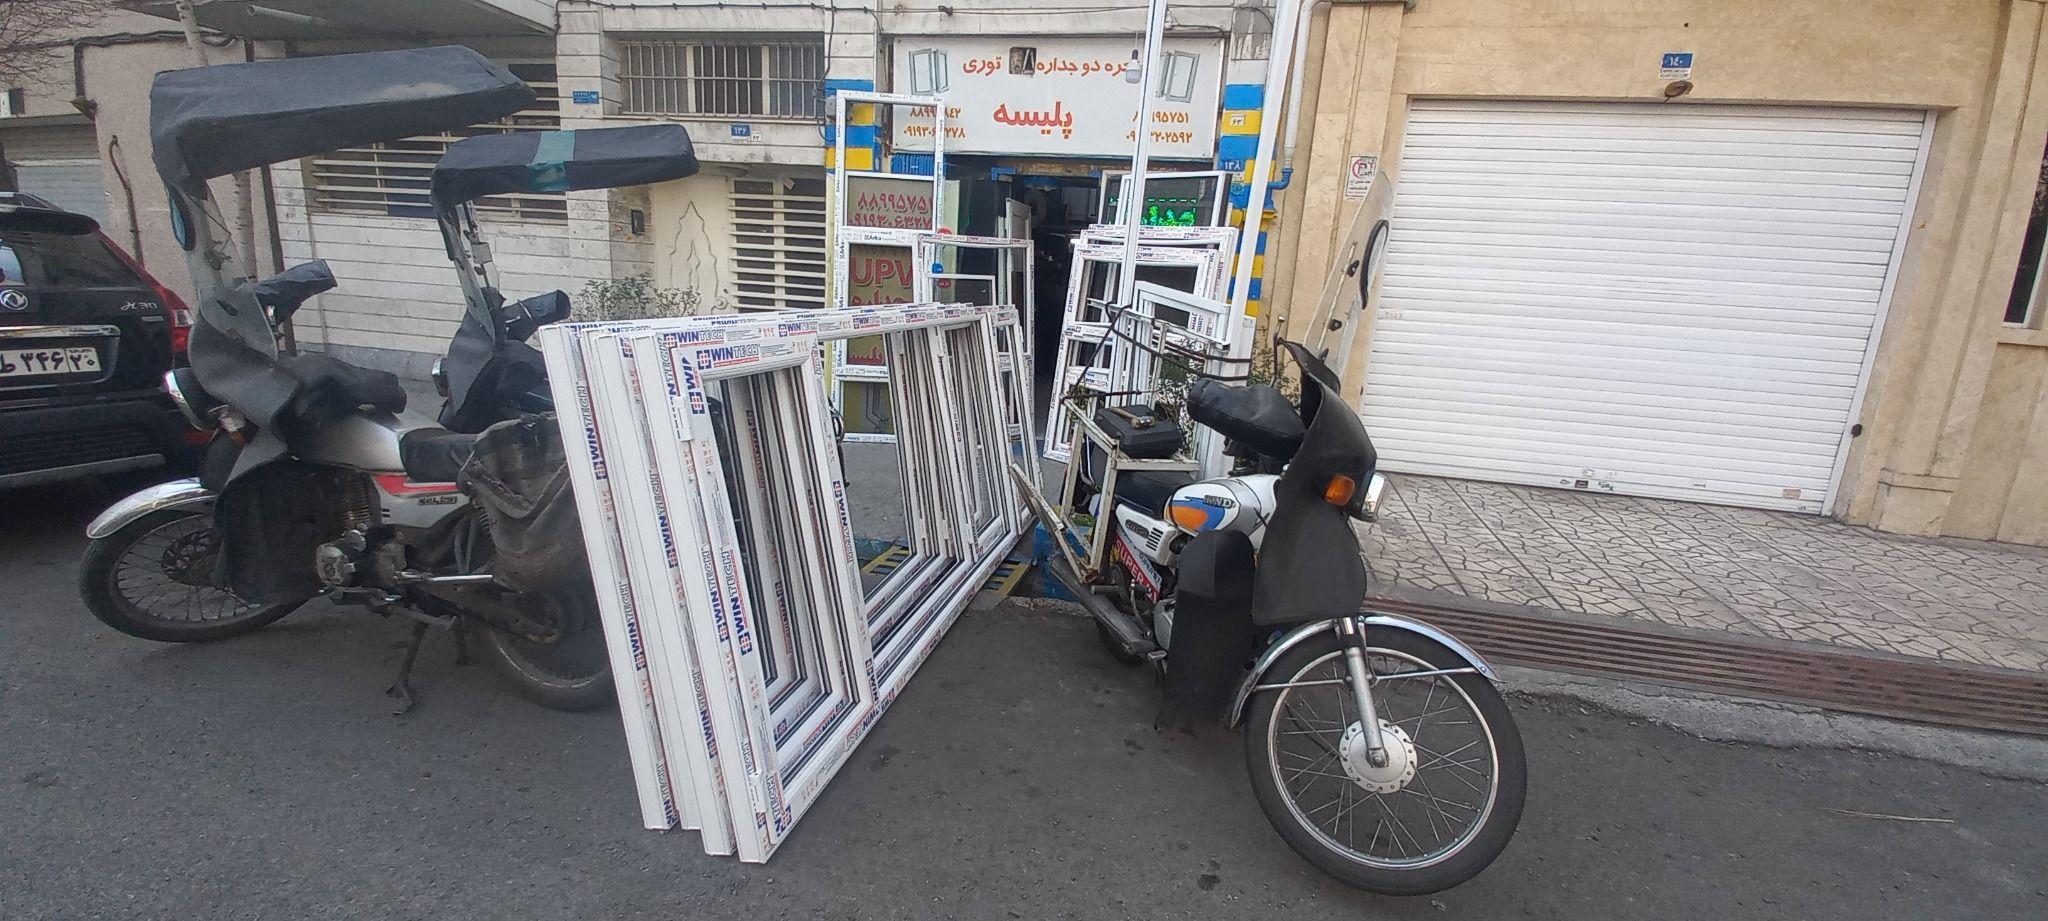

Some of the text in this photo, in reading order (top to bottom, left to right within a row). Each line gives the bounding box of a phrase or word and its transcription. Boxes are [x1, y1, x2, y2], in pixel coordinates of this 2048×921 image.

[963, 56, 1002, 77] توری
[1036, 57, 1079, 76] جداره
[1081, 59, 1101, 77] دو
[909, 106, 961, 119] ۸۸۹۹۸۴۲
[993, 101, 1073, 140] پلیسه
[678, 329, 725, 343] WINTECH
[787, 321, 819, 334] WINTECH
[20, 351, 65, 372] ۳۴۶
[69, 353, 96, 371] ۲۰
[656, 337, 677, 396] NTECH
[711, 344, 760, 361] WINTECH
[576, 383, 600, 461] WINTECH
[649, 471, 675, 550] WINTECH
[1115, 540, 1145, 586] SUPER
[701, 548, 721, 624] WINTECH
[720, 547, 746, 636] WINTECH
[619, 581, 641, 654] WINTECH
[692, 669, 716, 742] WINTECH
